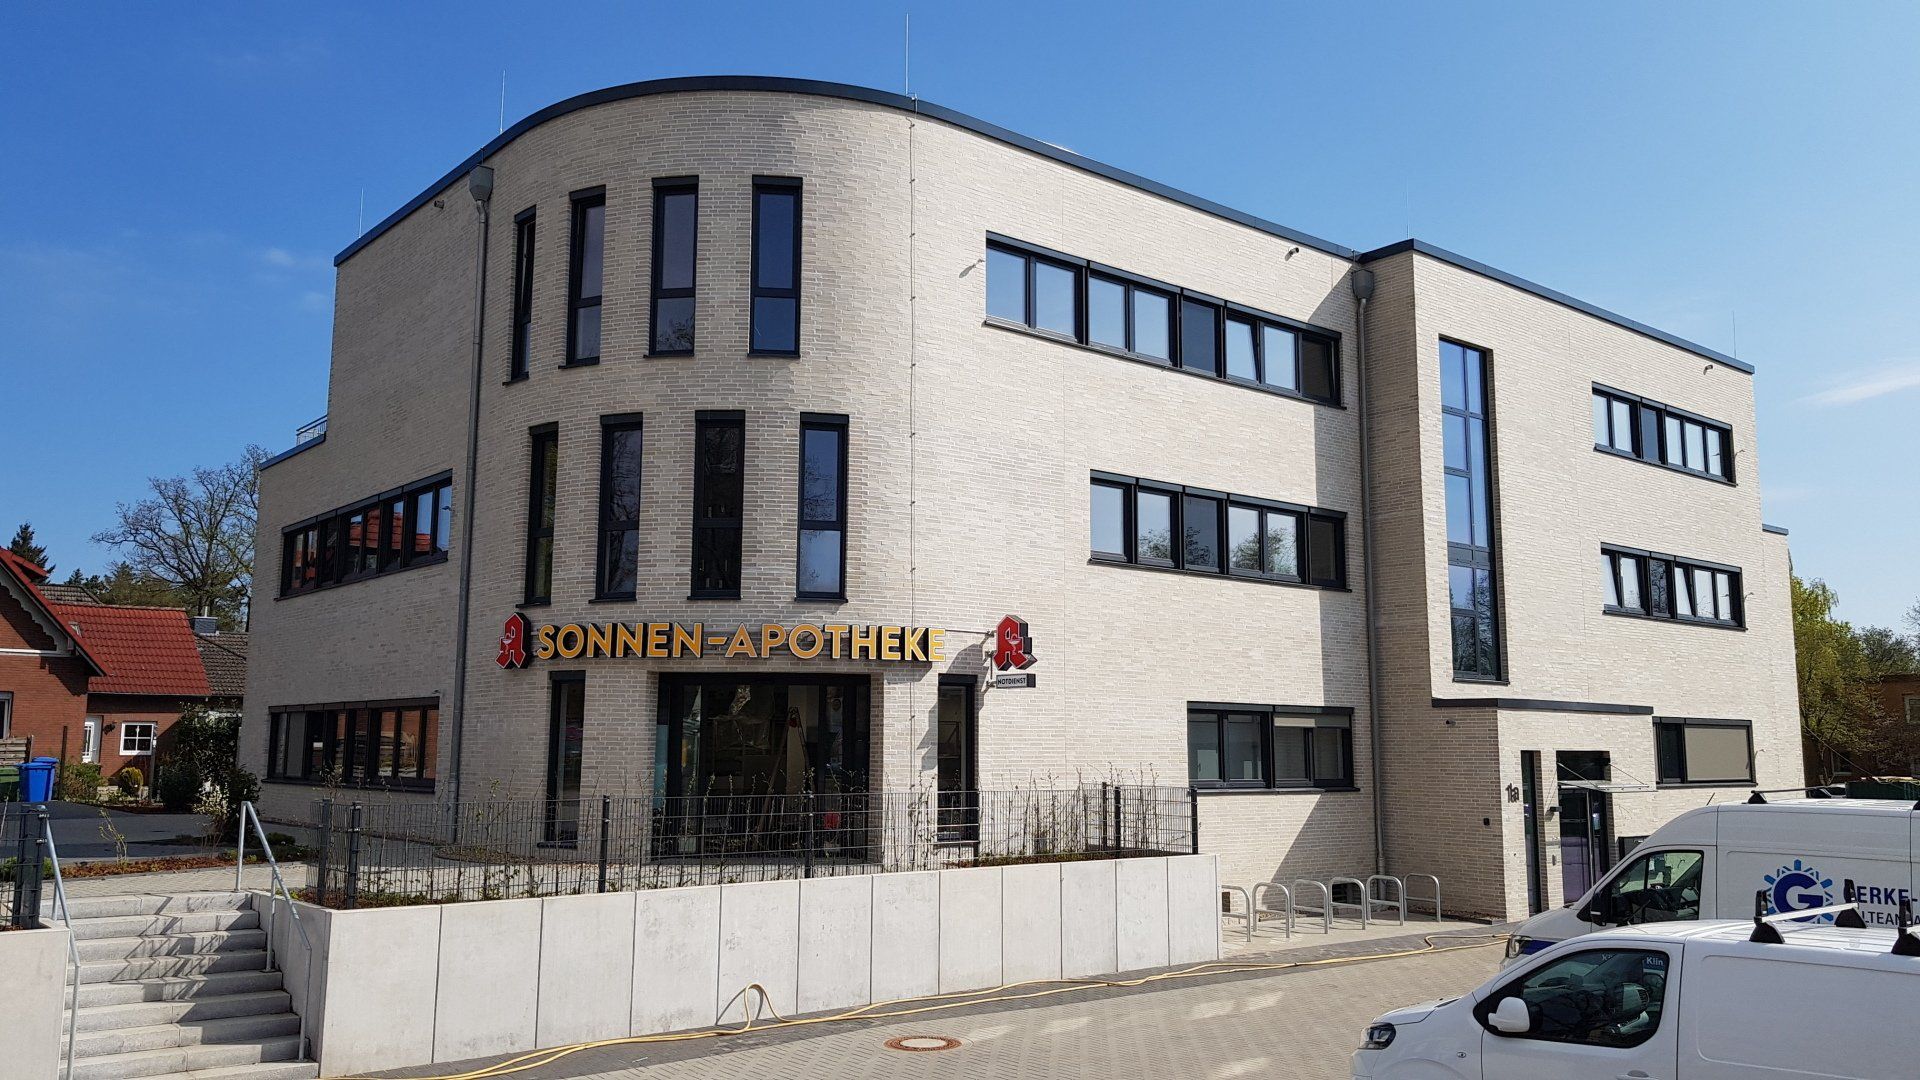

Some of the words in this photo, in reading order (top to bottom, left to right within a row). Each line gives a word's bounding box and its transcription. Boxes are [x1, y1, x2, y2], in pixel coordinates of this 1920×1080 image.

[537, 622, 946, 662] SONNEN-APOTHEKE
[997, 677, 1026, 685] NOTDIENST
[1855, 886, 1918, 906] ERKE-
